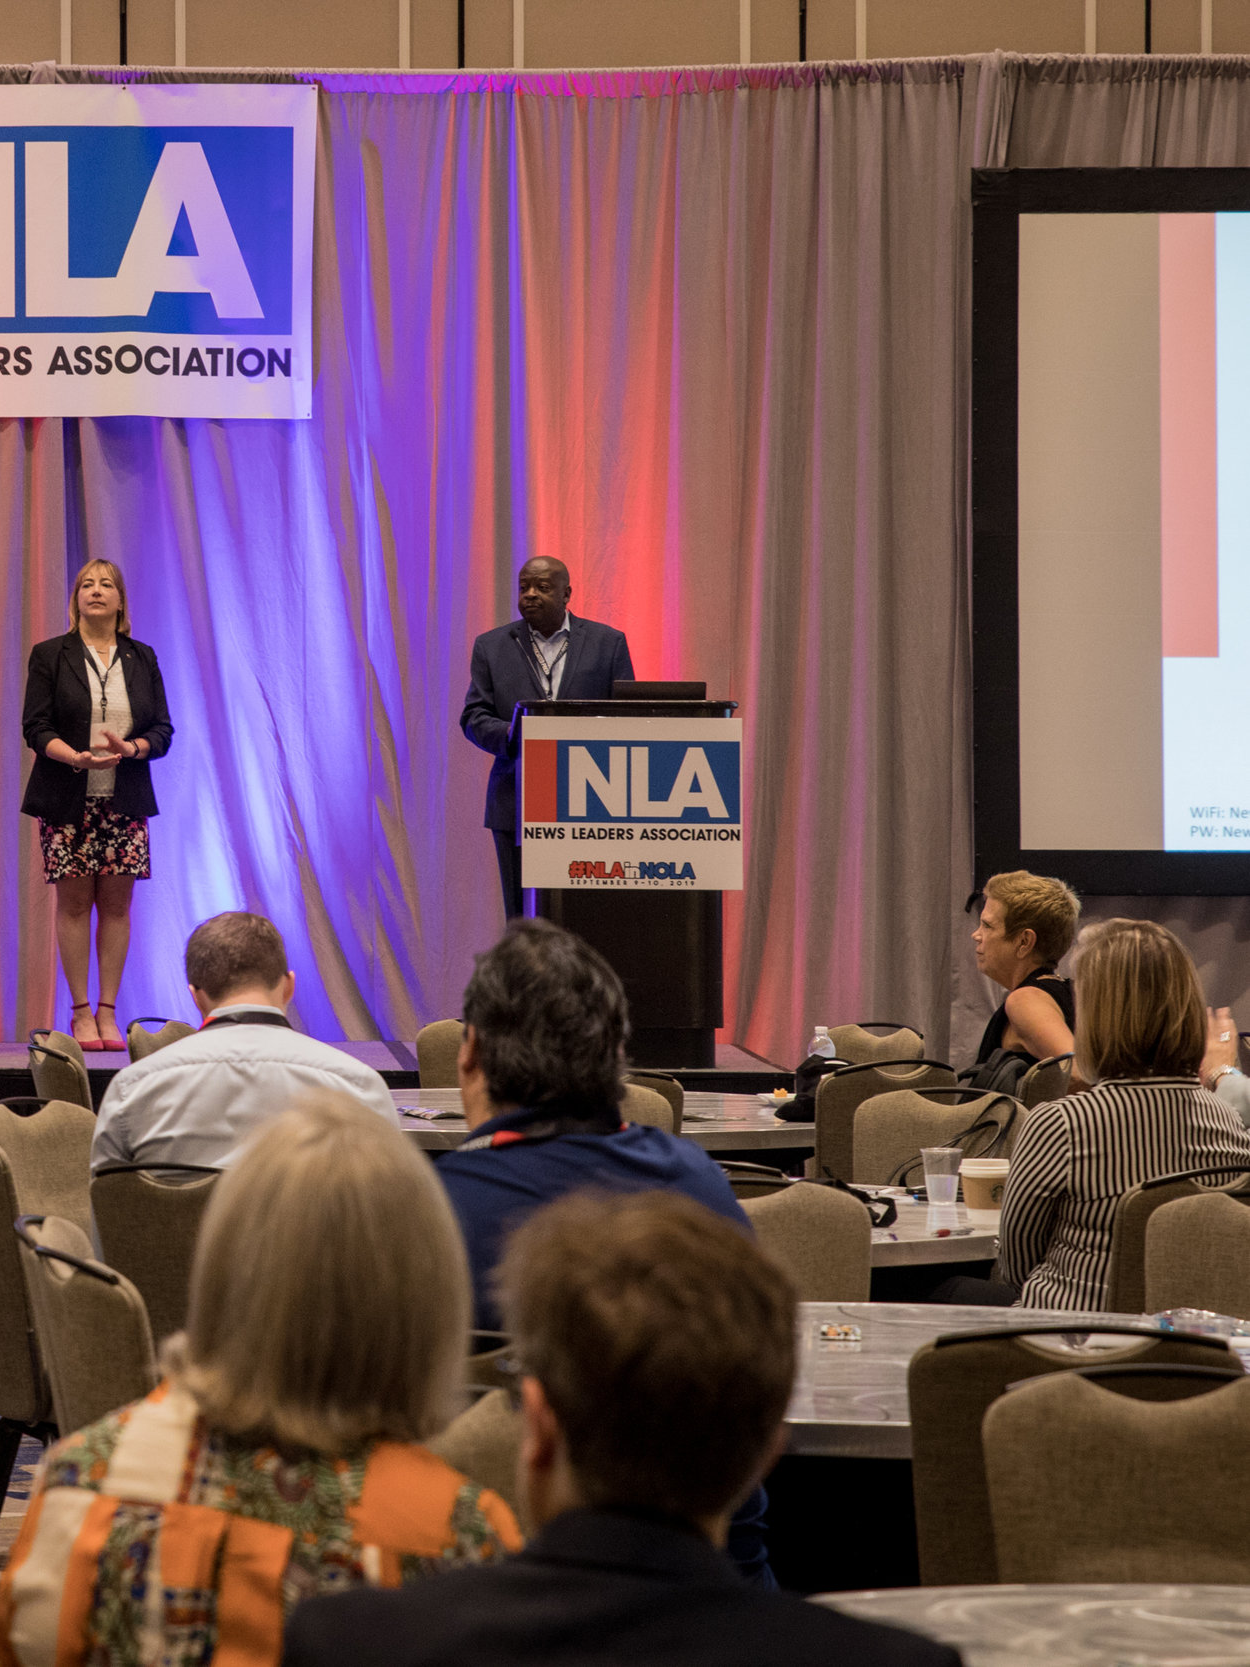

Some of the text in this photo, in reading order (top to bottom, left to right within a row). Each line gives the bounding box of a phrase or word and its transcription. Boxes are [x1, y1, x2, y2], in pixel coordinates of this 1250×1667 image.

[47, 344, 292, 378] ASSOCIATION
[568, 745, 730, 818] NLA
[1190, 806, 1250, 819] WiFi: Ne
[524, 827, 741, 841] NEWS LEADERS ASSOCIATION
[1190, 826, 1218, 838] PW:
